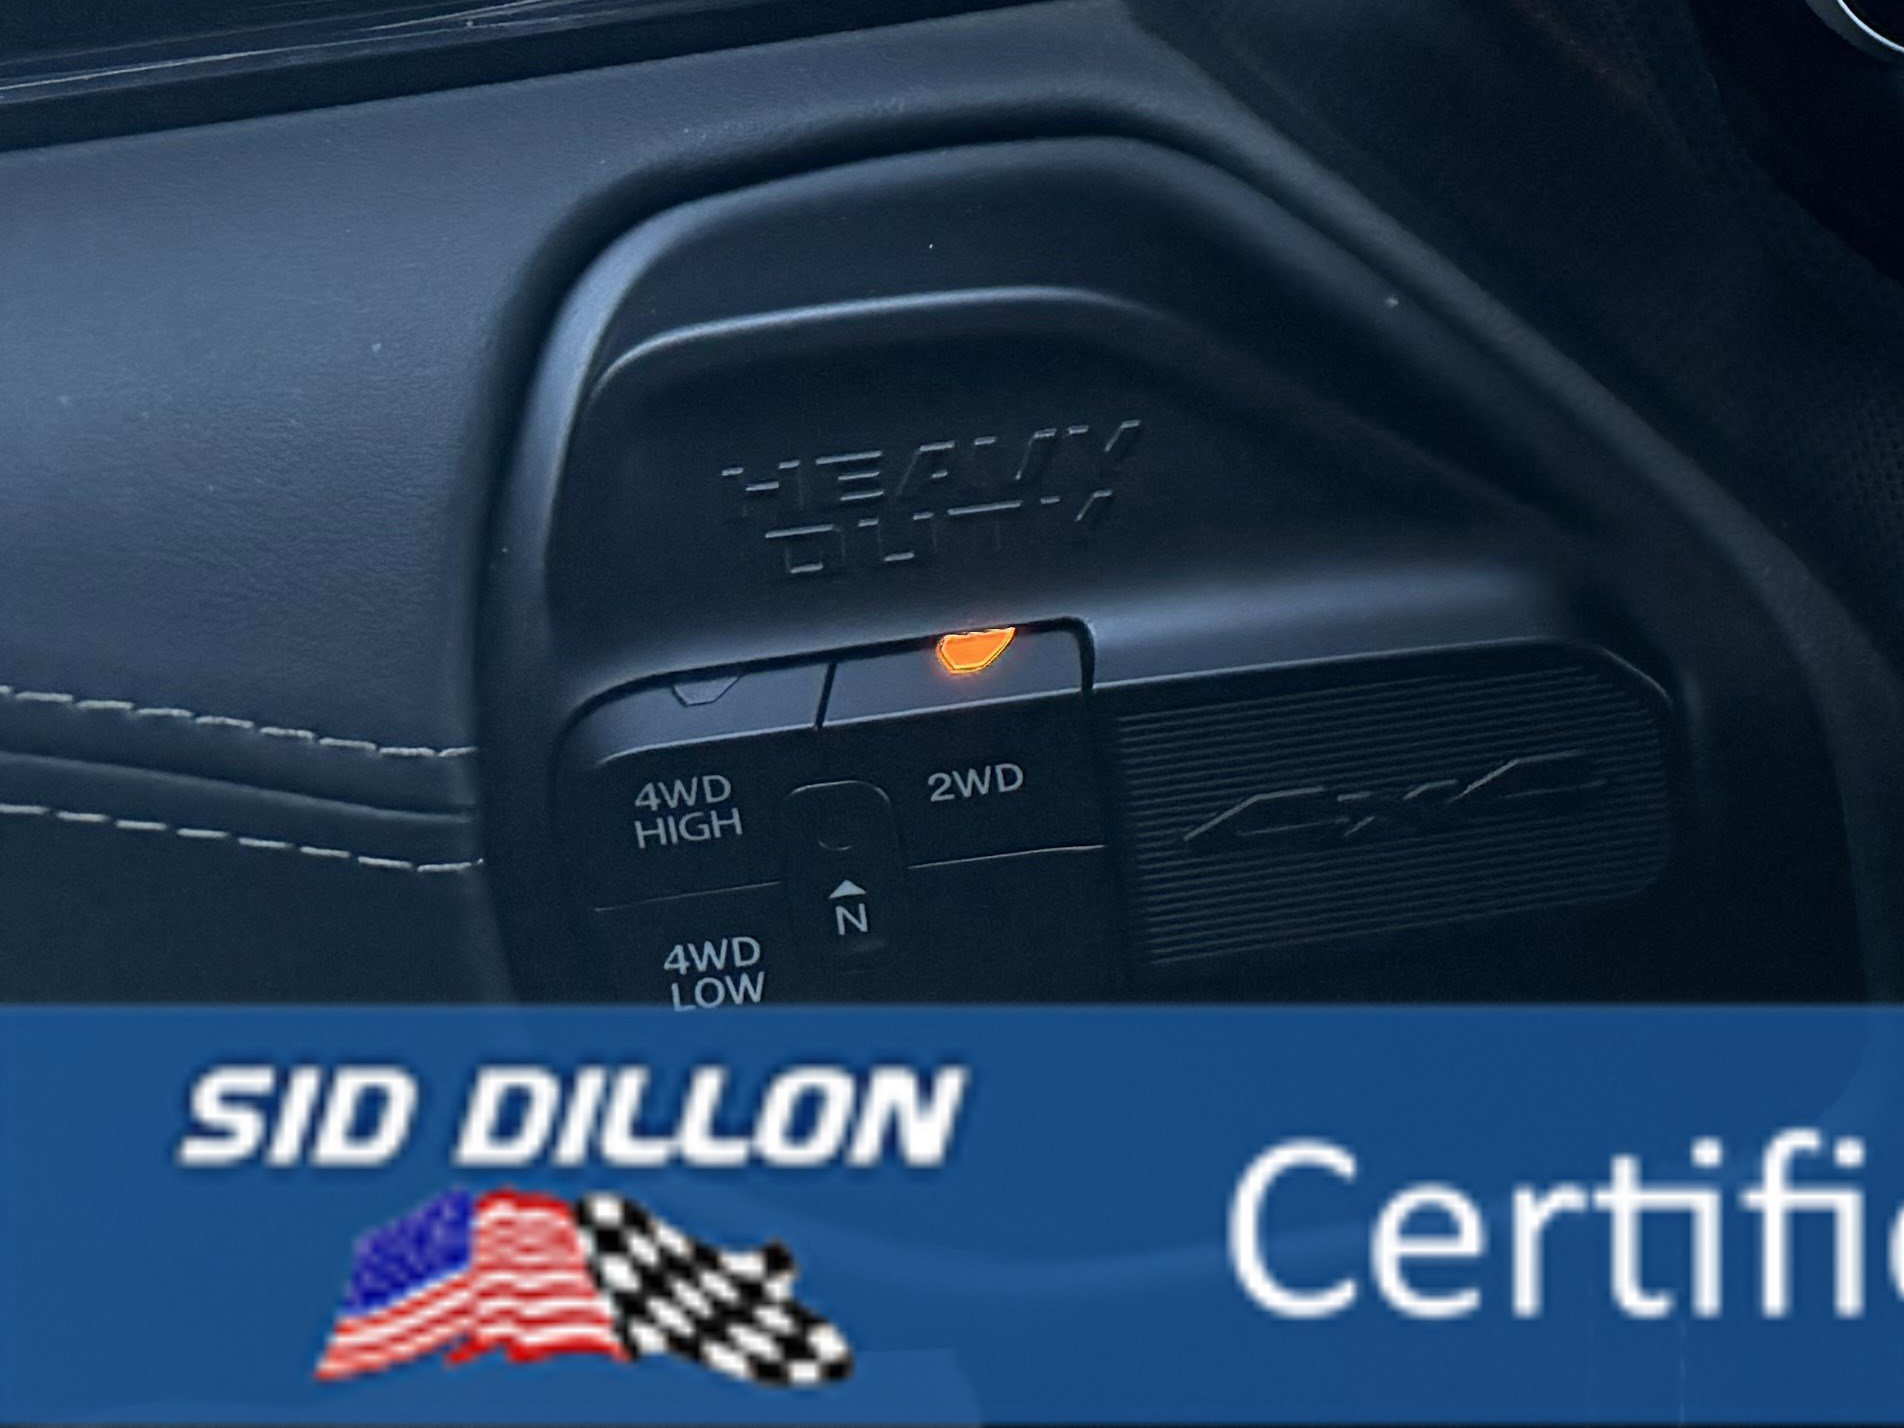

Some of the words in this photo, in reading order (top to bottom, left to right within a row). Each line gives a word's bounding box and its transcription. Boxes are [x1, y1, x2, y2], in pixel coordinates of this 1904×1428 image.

[722, 419, 1142, 519] HEAVY
[764, 489, 1113, 575] DUTY
[634, 773, 732, 812] 4WD
[926, 762, 1024, 803] 2WD
[633, 806, 744, 849] HIGH
[834, 902, 869, 936] N
[662, 935, 762, 976] 4WD
[670, 970, 766, 1013] LOW
